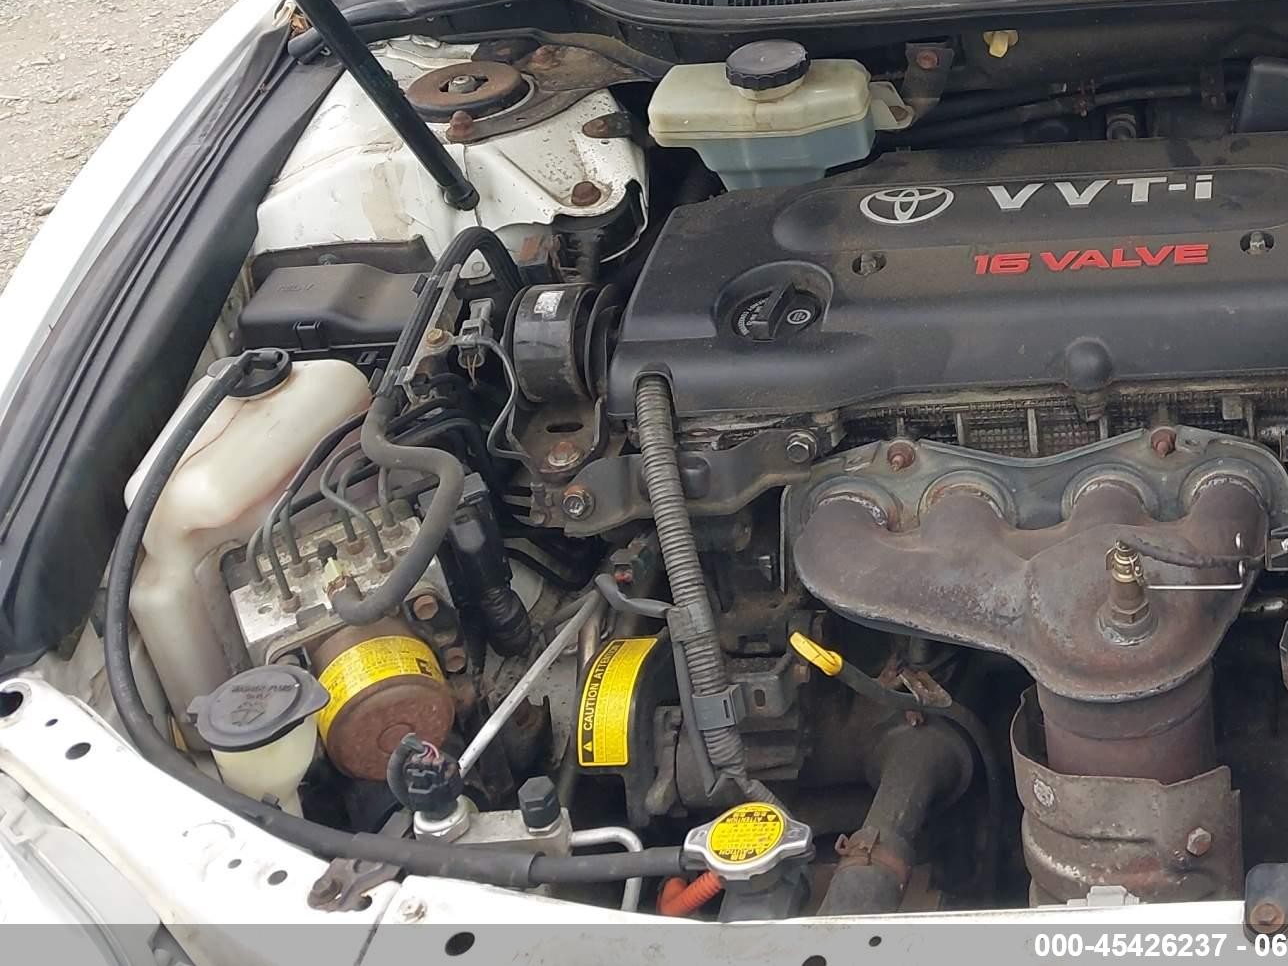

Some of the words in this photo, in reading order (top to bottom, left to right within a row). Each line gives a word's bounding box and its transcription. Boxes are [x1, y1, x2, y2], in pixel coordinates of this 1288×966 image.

[987, 174, 1213, 210] VVT-i
[975, 252, 1031, 275] 16
[1040, 243, 1209, 272] VALVE
[582, 682, 600, 732] CAUTION
